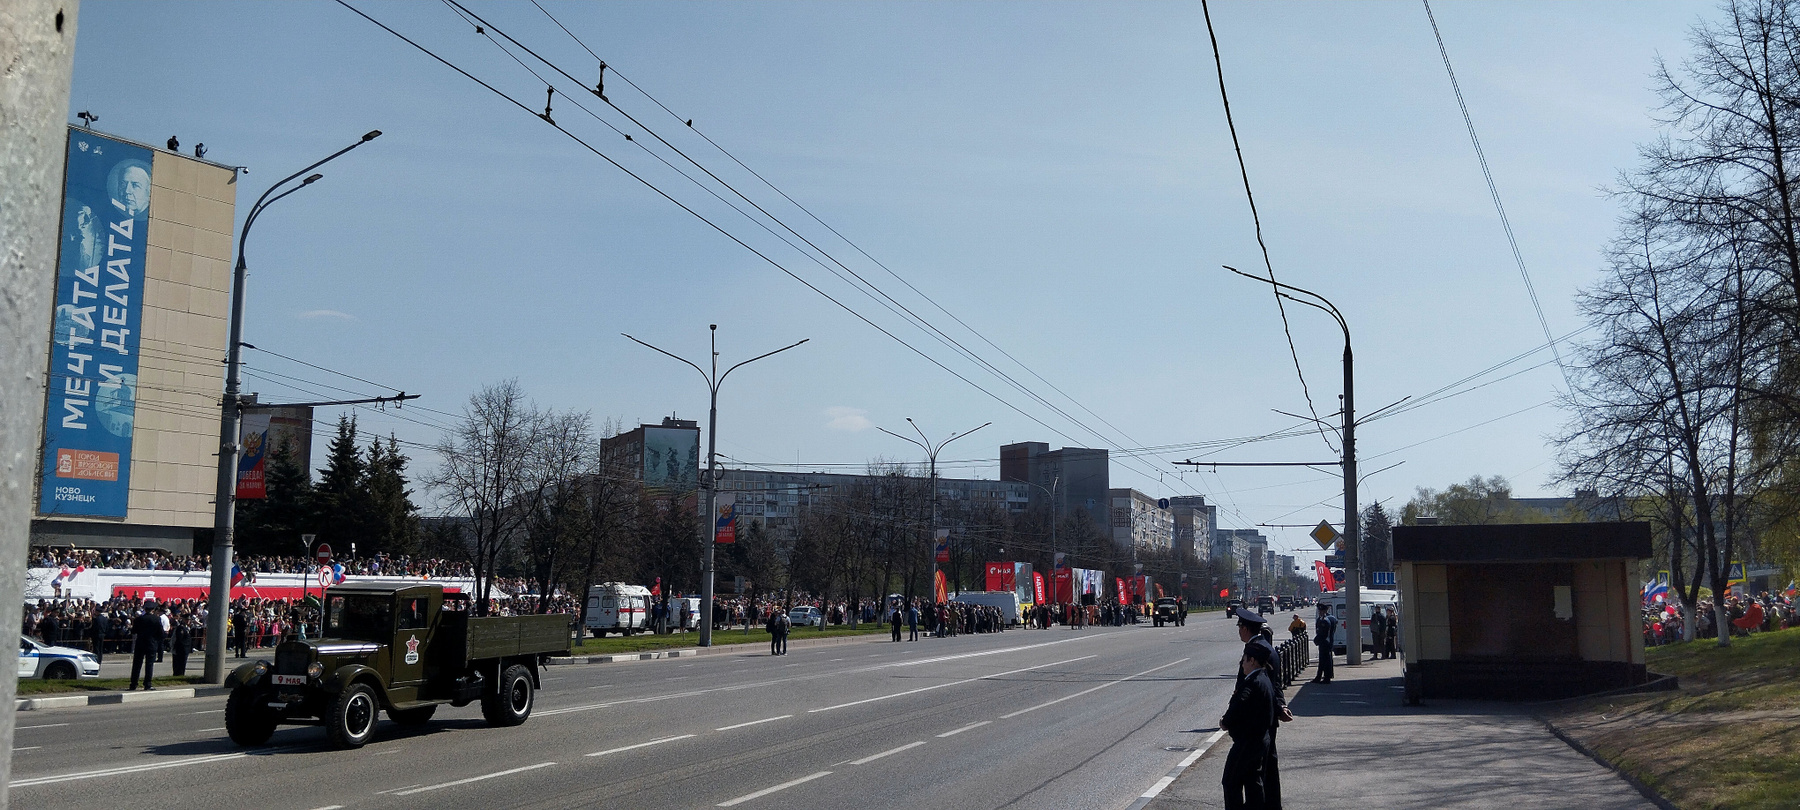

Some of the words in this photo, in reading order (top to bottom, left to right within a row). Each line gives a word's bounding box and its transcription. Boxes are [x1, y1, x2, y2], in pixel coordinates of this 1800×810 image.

[100, 197, 135, 356] ДЕЛАТЬ!
[62, 264, 100, 430] МЕЧТАТЬ
[98, 363, 123, 389] И
[55, 486, 81, 494] НОВО
[55, 494, 96, 503] КУЗНЕЦК
[277, 675, 284, 684] 9
[286, 677, 301, 685] МАЯ
